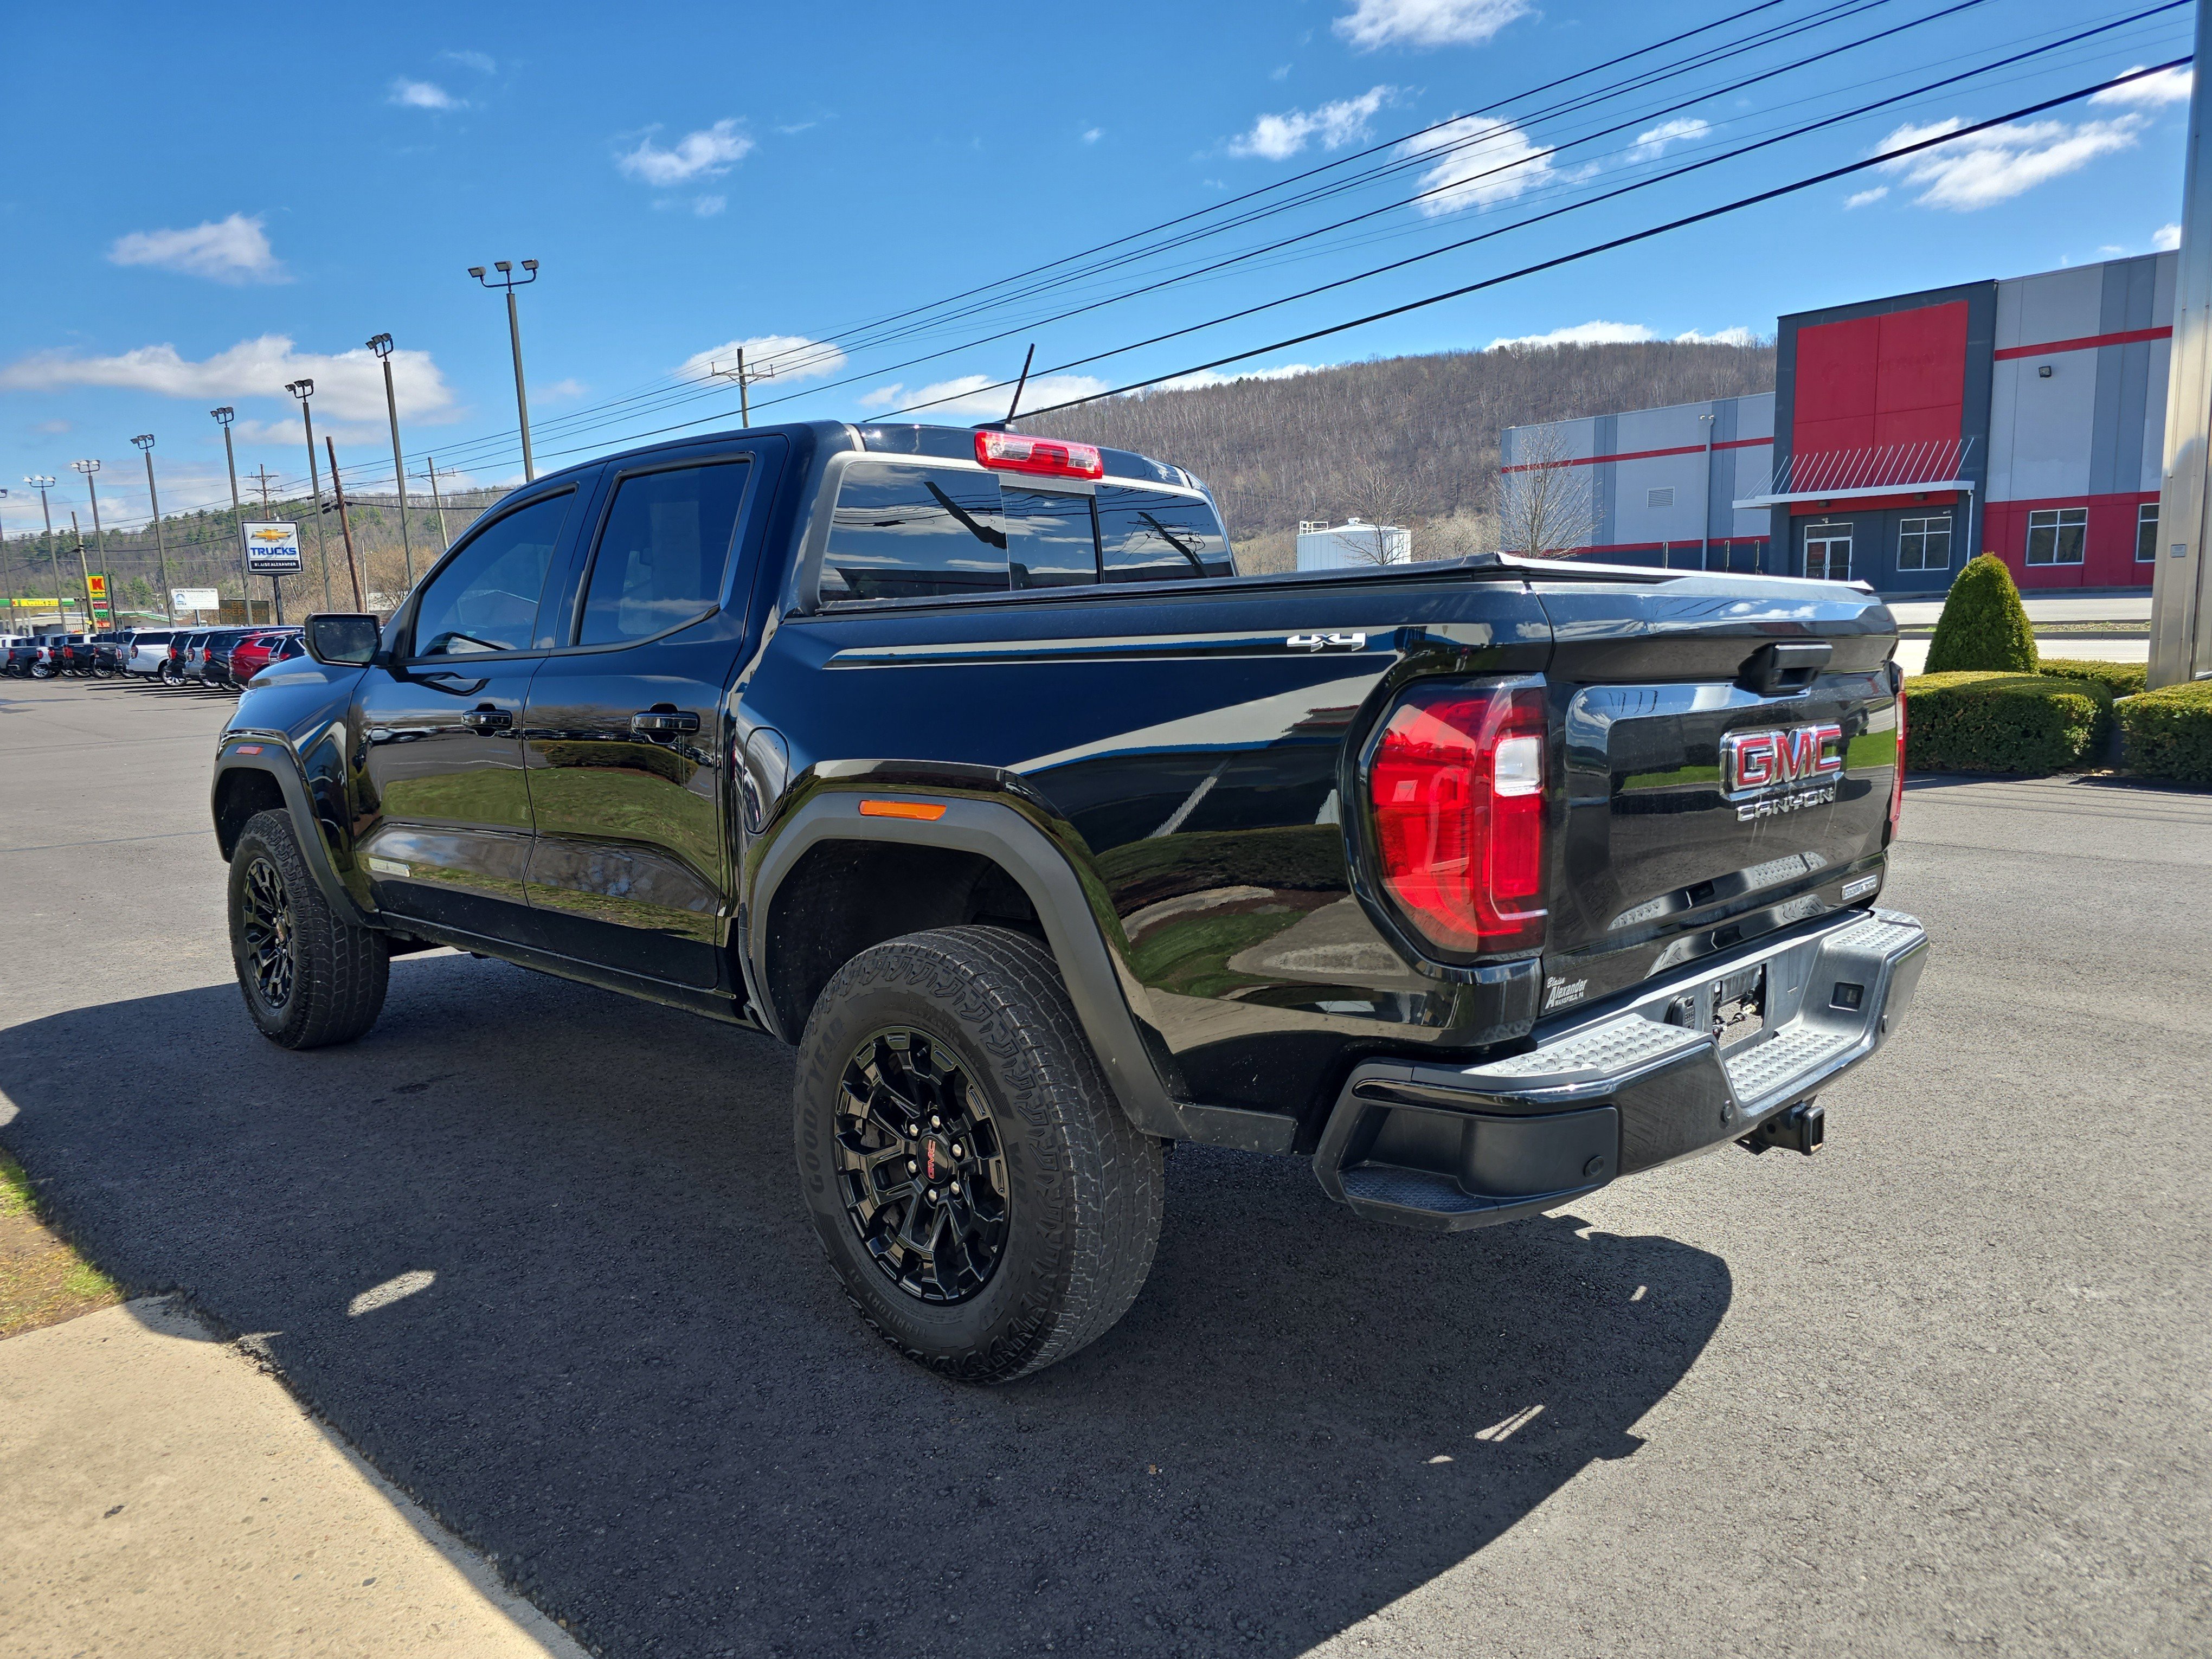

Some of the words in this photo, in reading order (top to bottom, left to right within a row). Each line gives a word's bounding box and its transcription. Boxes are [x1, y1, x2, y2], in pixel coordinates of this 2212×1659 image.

[250, 547, 297, 555] TRUCKS
[91, 578, 105, 590] K
[1732, 724, 1842, 791] GMC
[1737, 787, 1834, 821] CANYON
[1545, 978, 1588, 1009] Alexander
[928, 1139, 936, 1179] GMC
[866, 1291, 927, 1338] TERRITORY
